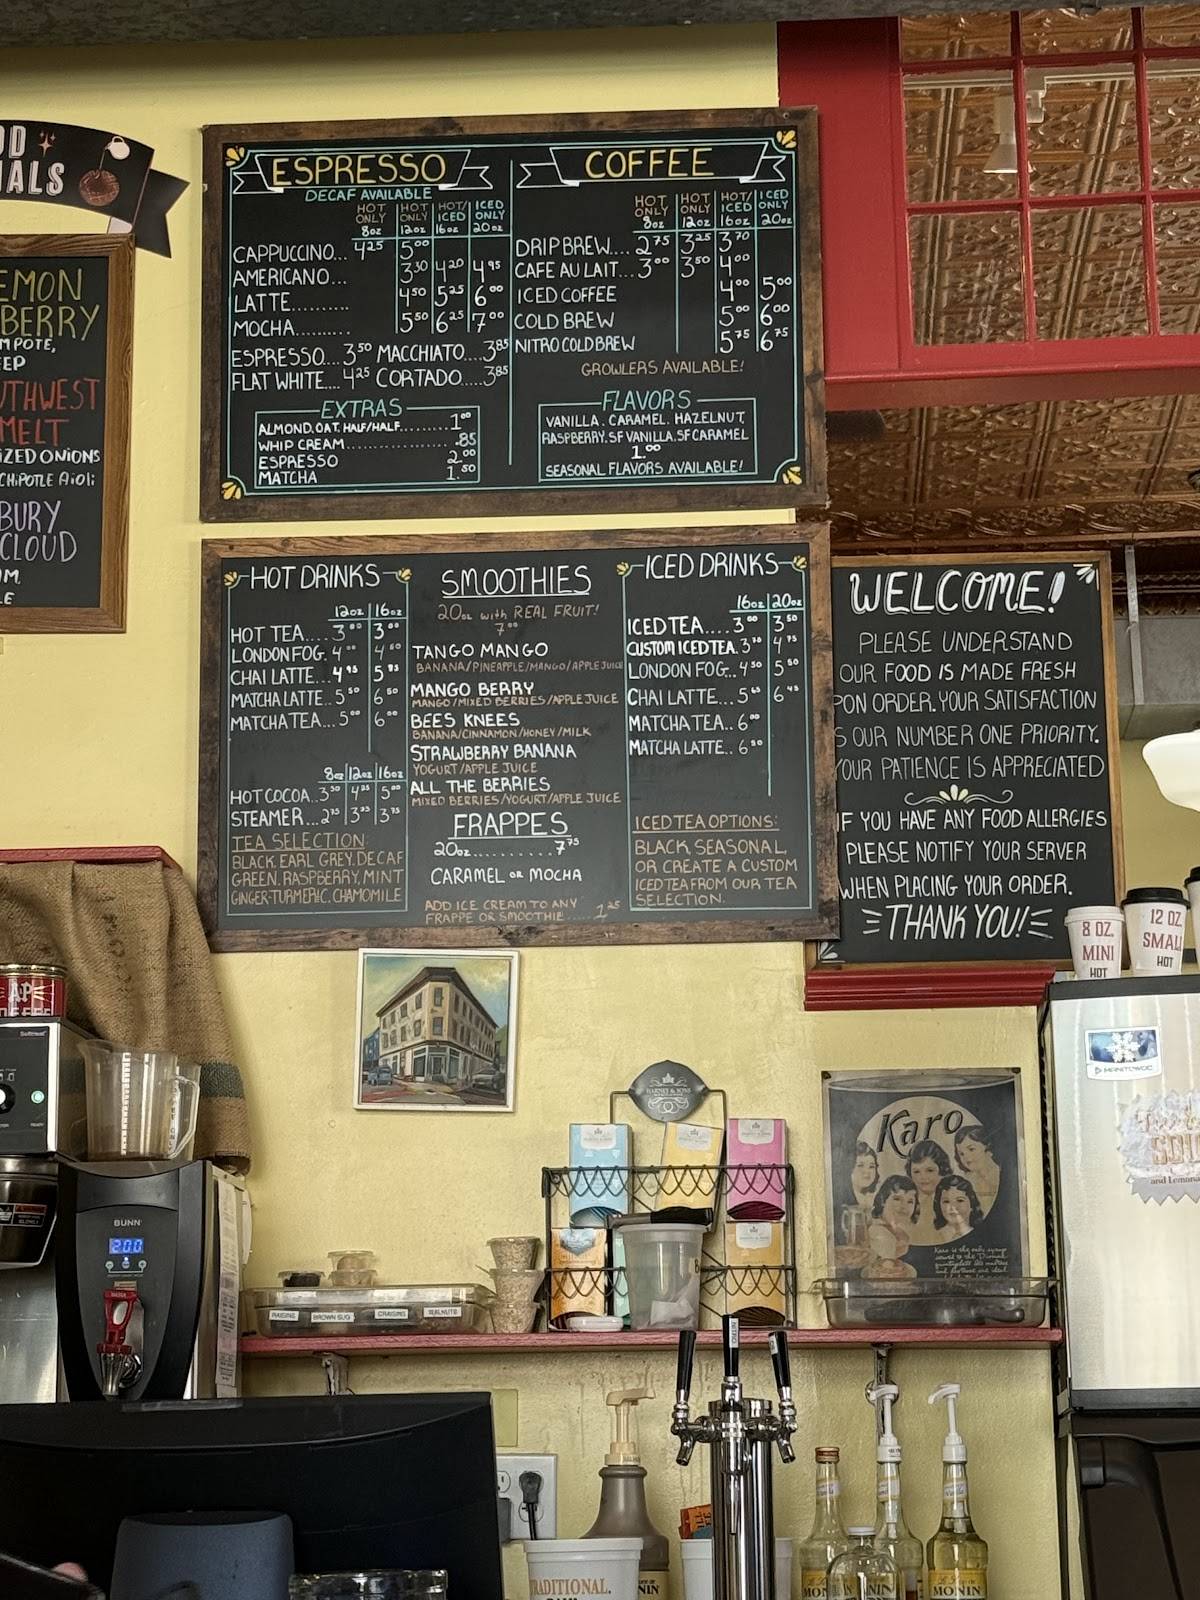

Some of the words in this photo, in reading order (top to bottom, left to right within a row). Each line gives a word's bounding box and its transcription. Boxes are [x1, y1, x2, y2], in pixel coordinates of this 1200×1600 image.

[272, 152, 447, 186] ESPRESSO
[585, 147, 715, 179] COFFEE
[304, 188, 356, 202] DECAF
[360, 186, 433, 201] AVAILABLE
[634, 194, 668, 208] HOT
[680, 192, 711, 205] HOT
[759, 189, 790, 201] ICED
[356, 203, 387, 214] HOT
[400, 202, 430, 213] HOT
[475, 199, 505, 211] ICED
[634, 205, 669, 218] ONLY
[680, 203, 713, 215] ONLY
[721, 201, 753, 213] ICED
[758, 199, 790, 211] ONLY
[355, 213, 387, 224] ONLY
[400, 212, 429, 223] ONLY
[437, 211, 466, 222] ICED
[475, 210, 506, 221] ONLY
[518, 285, 558, 304] ICED
[560, 285, 617, 304] COFFEE
[514, 312, 560, 331] COLD
[563, 311, 615, 330] BREW
[515, 335, 561, 354] NITRO
[561, 336, 596, 352] COLD
[596, 335, 636, 352] BREW
[581, 360, 658, 377] GROWLERS
[662, 358, 745, 375] AVAILABLE!
[320, 398, 403, 419] EXTRAS
[603, 388, 692, 411] FLAVORS
[258, 454, 339, 470] ESPRESSO
[545, 463, 606, 478] SEASONAL
[607, 461, 664, 476] FLAVORS
[668, 459, 744, 475] AVAILABLE!
[258, 470, 318, 486] MATCHA
[0, 530, 77, 562] CLOUD
[645, 553, 694, 580] ICED
[699, 552, 779, 578] DRINKS
[251, 565, 296, 590] HOT
[300, 563, 381, 589] DRINKS
[441, 565, 592, 596] SMOOTHIES
[849, 568, 1067, 616] WELCOME!
[513, 604, 548, 620] REAL
[553, 603, 600, 618] FRUIT!
[412, 643, 475, 660] TANGO
[480, 642, 549, 659] MANGO
[859, 630, 933, 655] PLEASE
[942, 630, 1074, 655] UNDERSTAND
[839, 662, 878, 684] OUR
[884, 662, 932, 683] FOOD
[938, 662, 955, 682] IS
[960, 661, 1015, 682] MADE
[1021, 660, 1077, 681] FRESH
[410, 682, 471, 698] MANGO
[478, 681, 535, 697] BERRY
[872, 691, 937, 713] ORDER.
[938, 689, 980, 713] YOUR
[983, 688, 1098, 712] SATISFACTION
[410, 713, 456, 729] BEES
[463, 712, 521, 728] KNEES
[852, 725, 889, 748] OUR
[896, 723, 975, 748] NUMBER
[979, 723, 1014, 746] ONE
[1020, 723, 1101, 745] PRIORITY.
[410, 744, 509, 762] STRAWBERRY
[513, 743, 578, 759] BANANA
[881, 755, 961, 781] PATIENCE
[967, 756, 986, 779] IS
[991, 754, 1106, 779] APPRECIATED
[410, 781, 441, 796] ALL
[446, 779, 477, 794] THE
[482, 776, 551, 793] BERRIES
[453, 811, 569, 838] FRAPPES
[635, 815, 672, 831] ICED
[673, 814, 705, 830] TEA
[836, 811, 854, 833] IF
[859, 810, 892, 832] YOU
[899, 809, 937, 831] HAVE
[943, 808, 976, 830] ANY
[982, 808, 1024, 830] FOOD
[1025, 807, 1108, 829] ALLERGIES
[845, 840, 911, 866] PLEASE
[915, 840, 976, 864] NOTIFY
[981, 840, 1022, 863] YOUR
[1025, 839, 1088, 862] SERVER
[635, 859, 658, 874] OR
[662, 858, 722, 874] CREATE
[726, 858, 738, 872] A
[741, 858, 799, 872] CUSTOM
[430, 867, 506, 886] CARAMEL
[529, 867, 583, 883] MOCHA
[838, 875, 890, 900] WHEN
[894, 873, 959, 899] PLACING
[963, 873, 1003, 897] YOUR
[1008, 872, 1074, 896] ORDER.
[885, 902, 969, 941] THANK
[973, 902, 1031, 940] YOU!
[1150, 908, 1164, 925] 12
[1082, 921, 1091, 937] 8
[1082, 944, 1114, 961] MINI
[1157, 955, 1174, 969] HOT
[1089, 967, 1108, 979] HOT
[876, 1108, 963, 1160] Karo
[113, 1219, 142, 1227] BUNN
[932, 1584, 982, 1597] MONIN
